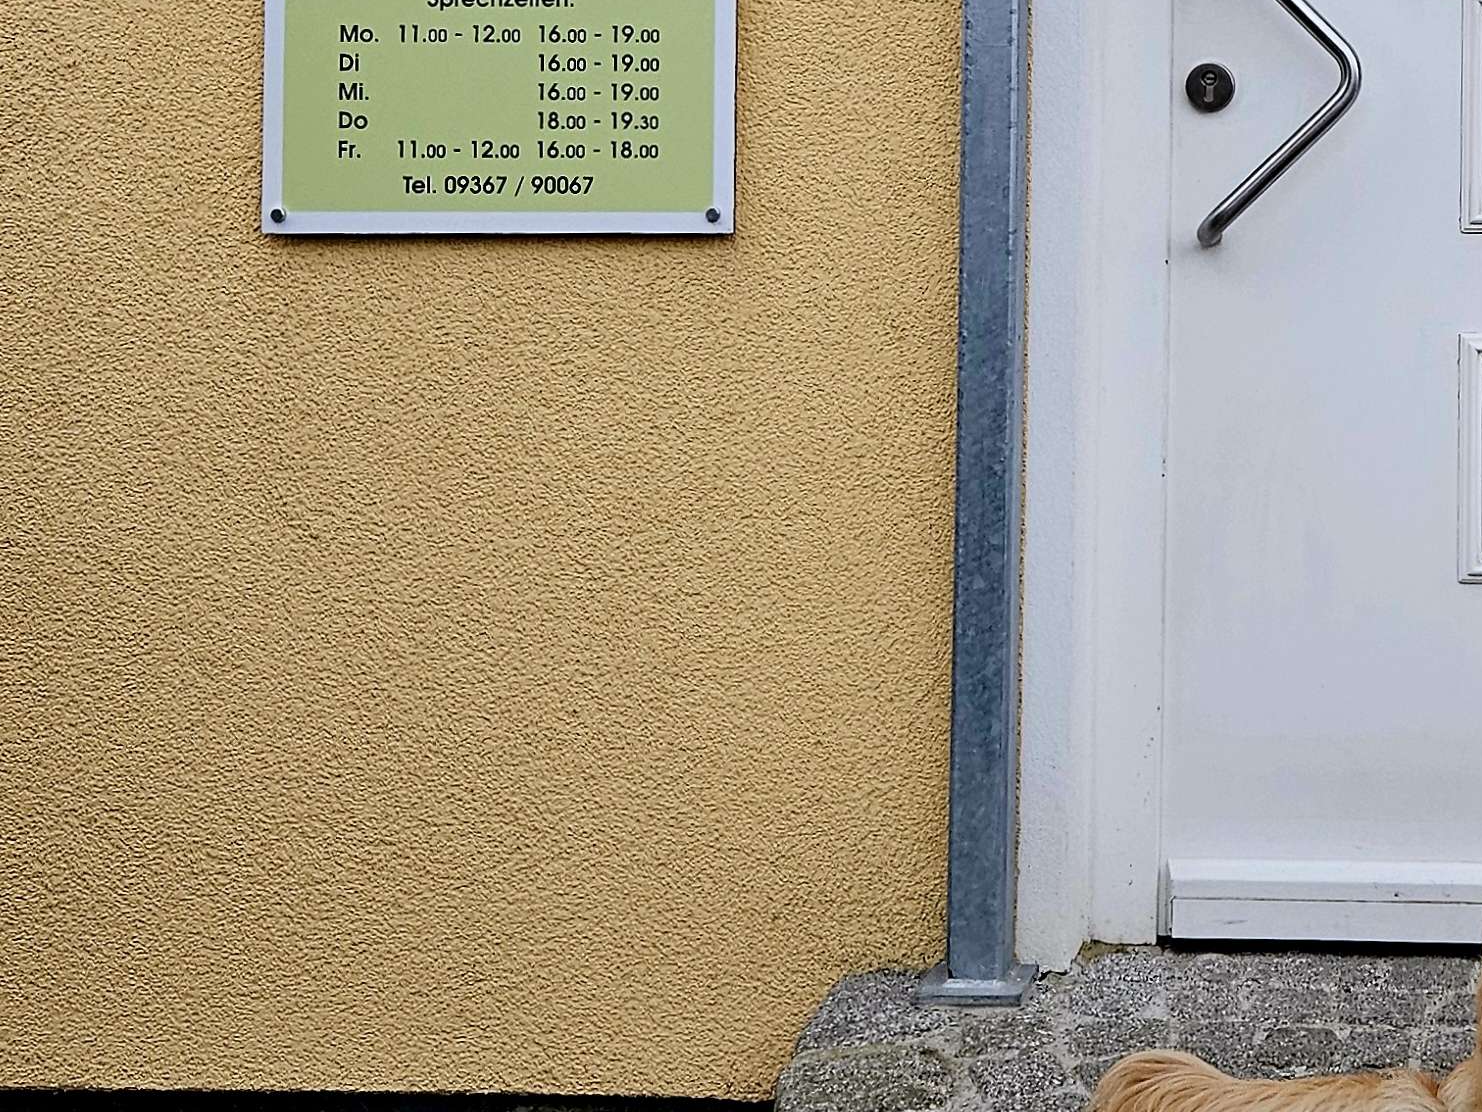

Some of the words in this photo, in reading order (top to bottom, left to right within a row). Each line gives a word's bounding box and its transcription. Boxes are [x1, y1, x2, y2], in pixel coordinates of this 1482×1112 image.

[339, 24, 379, 43] Mo.
[399, 24, 448, 43] 11.00
[472, 24, 521, 44] 12.00
[538, 24, 587, 44] 16.00
[611, 24, 660, 44] 19.00
[339, 52, 360, 72] Di
[538, 53, 587, 73] 16.00
[611, 53, 660, 73] 19.00
[338, 82, 370, 101] Mi.
[537, 82, 586, 102] 16.00
[610, 82, 660, 102] 19.00
[338, 110, 369, 130] Do
[537, 111, 587, 130] 18.00
[610, 111, 659, 130] 19.30
[338, 139, 361, 159] Fr.
[397, 139, 447, 159] 11.00
[471, 140, 520, 159] 12.00
[537, 140, 586, 159] 16.00
[610, 140, 659, 159] 18.00
[402, 175, 437, 194] Tel.
[444, 175, 508, 195] 09367
[514, 175, 525, 198] /
[530, 175, 594, 195] 90067
